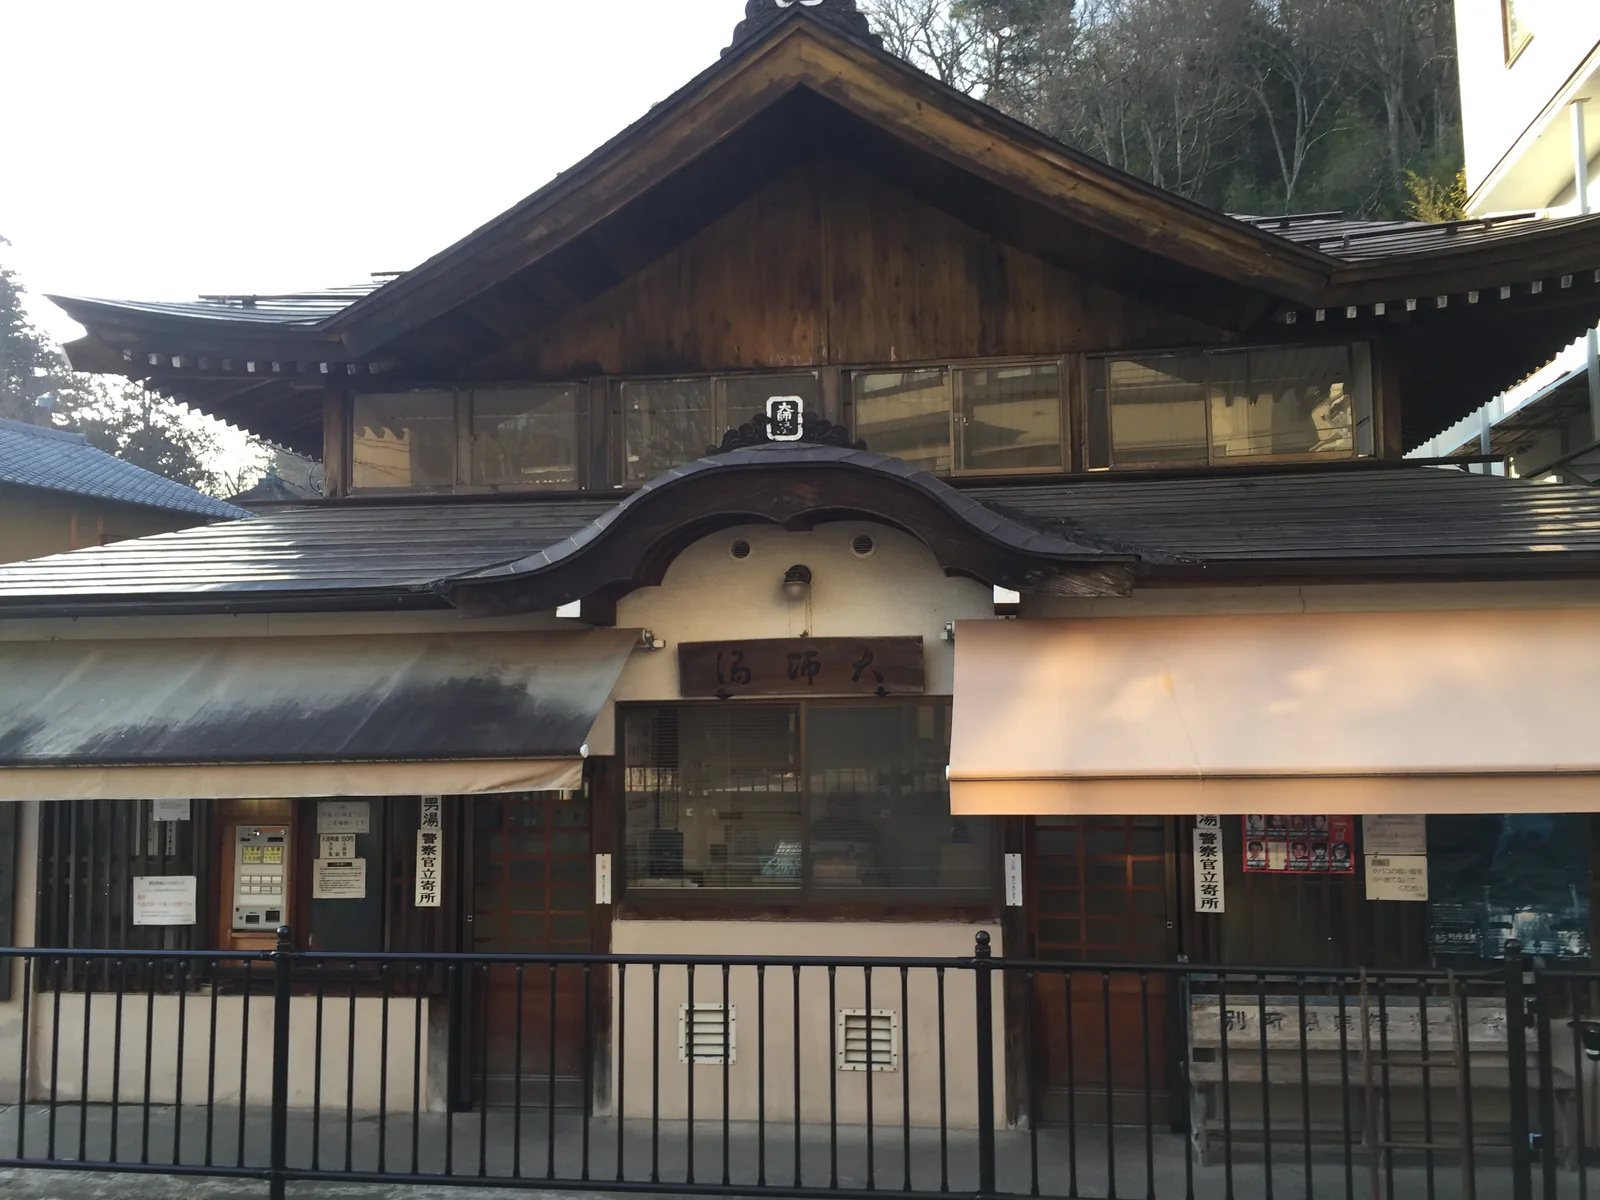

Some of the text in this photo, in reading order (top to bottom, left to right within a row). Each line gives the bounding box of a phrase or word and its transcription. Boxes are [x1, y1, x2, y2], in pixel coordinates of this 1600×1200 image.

[422, 797, 439, 828] 男湯
[418, 832, 437, 904] 警察官立寄所
[1198, 831, 1219, 910] 警察官立寄所
